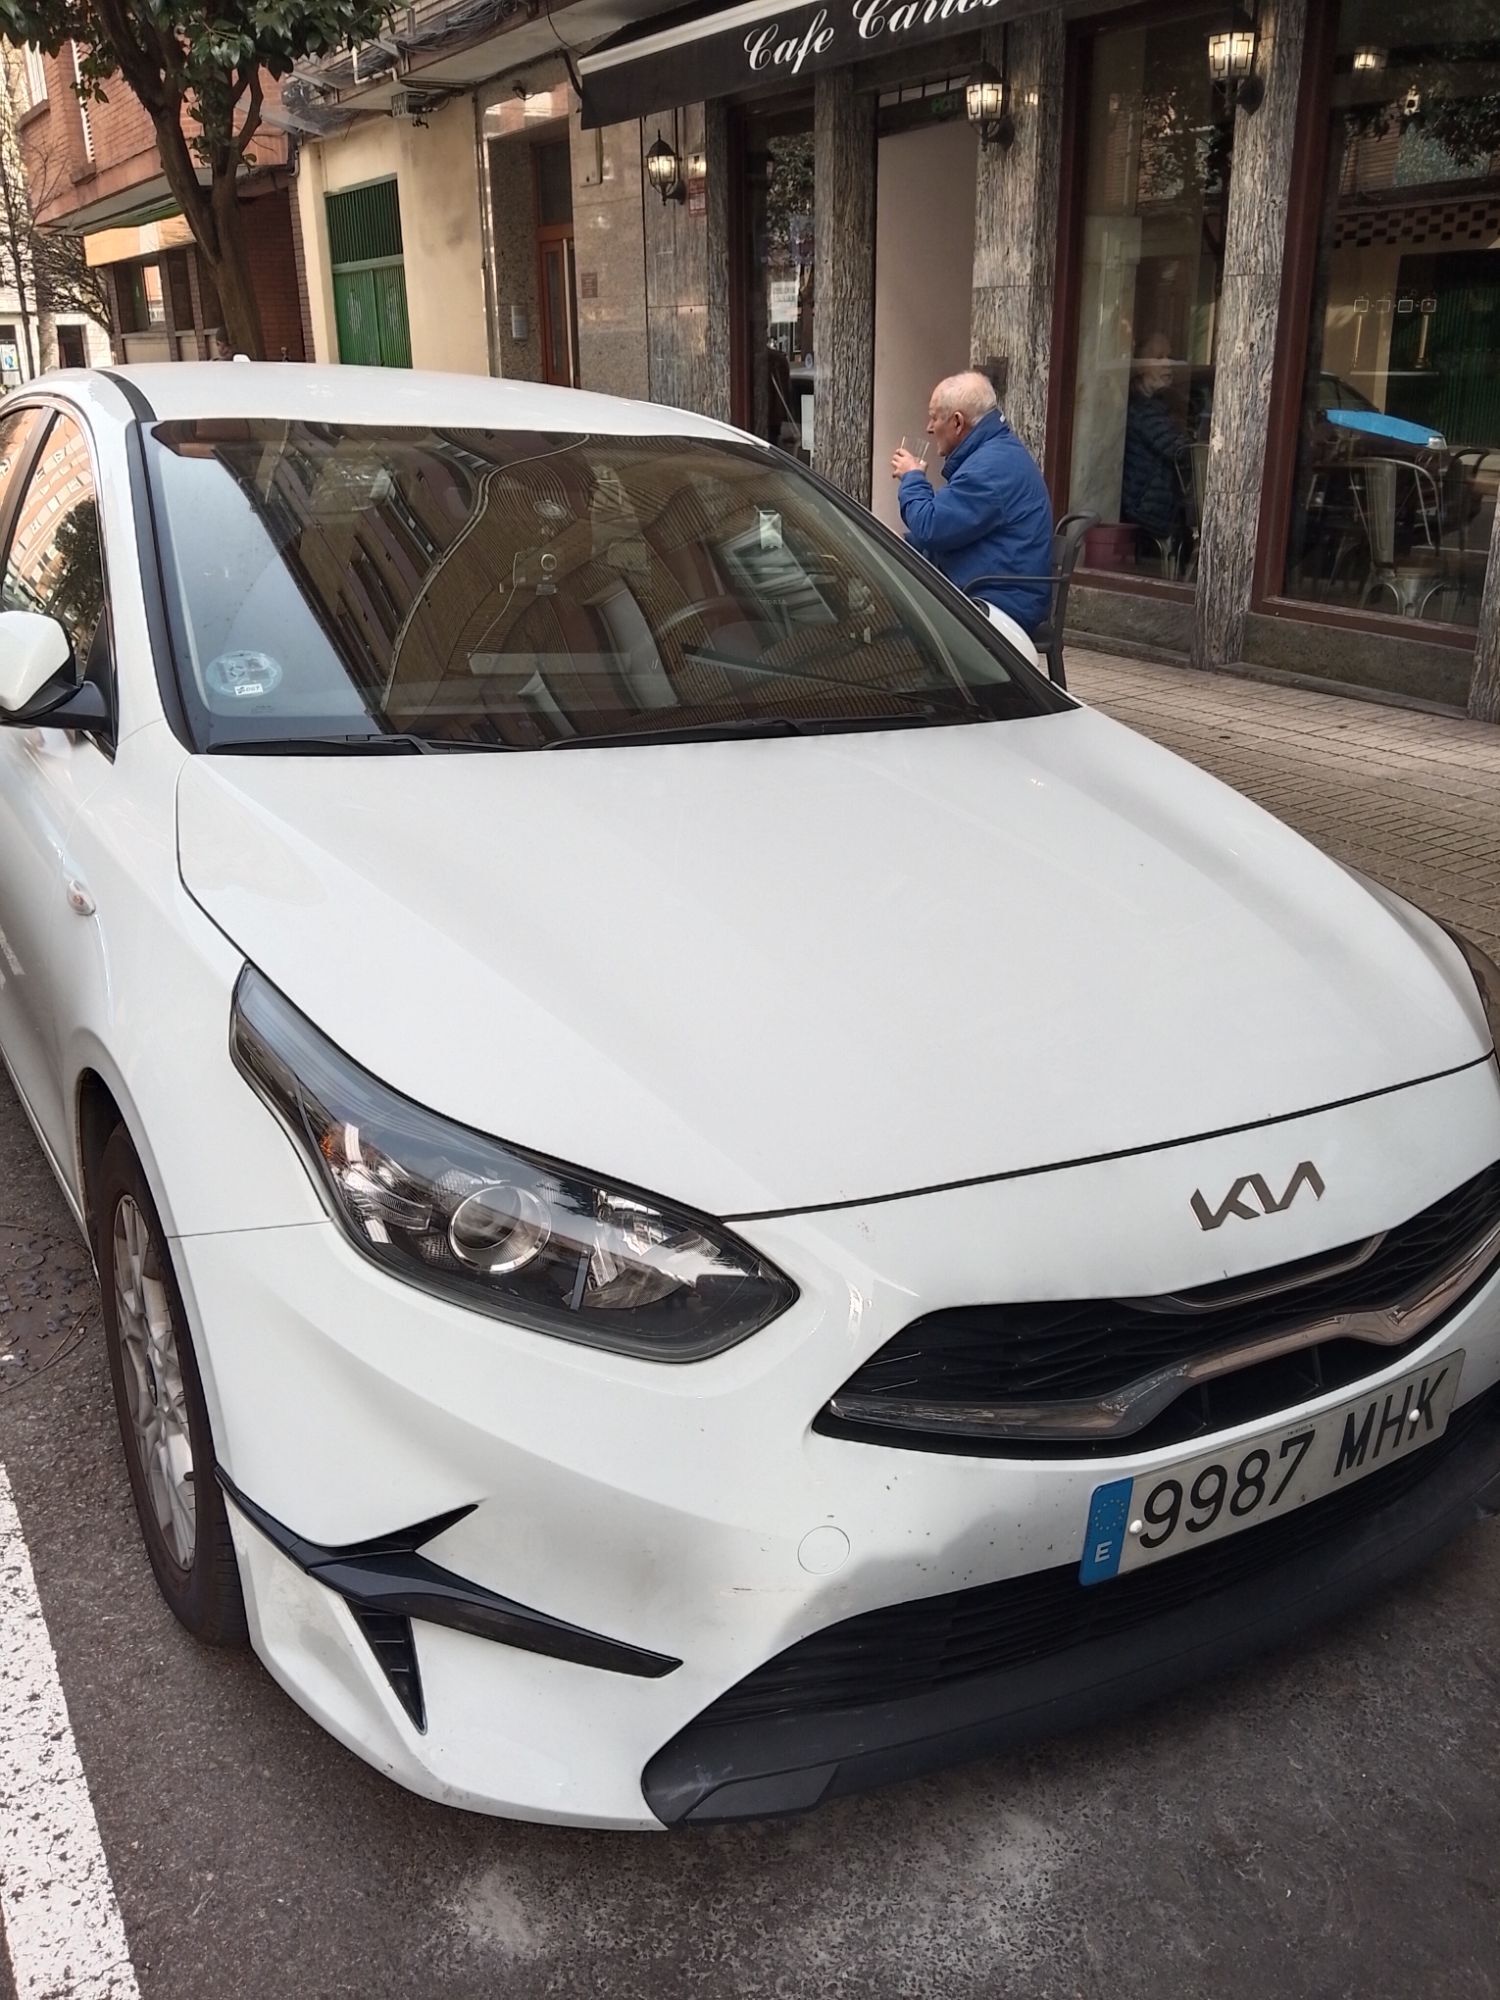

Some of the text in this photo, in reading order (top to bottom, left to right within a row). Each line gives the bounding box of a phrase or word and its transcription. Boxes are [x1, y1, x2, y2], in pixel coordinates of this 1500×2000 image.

[744, 0, 1000, 74] Cafe Caro
[1189, 1160, 1326, 1231] KIA
[1139, 1367, 1449, 1549] 9987 MHK
[1094, 1541, 1113, 1563] E
